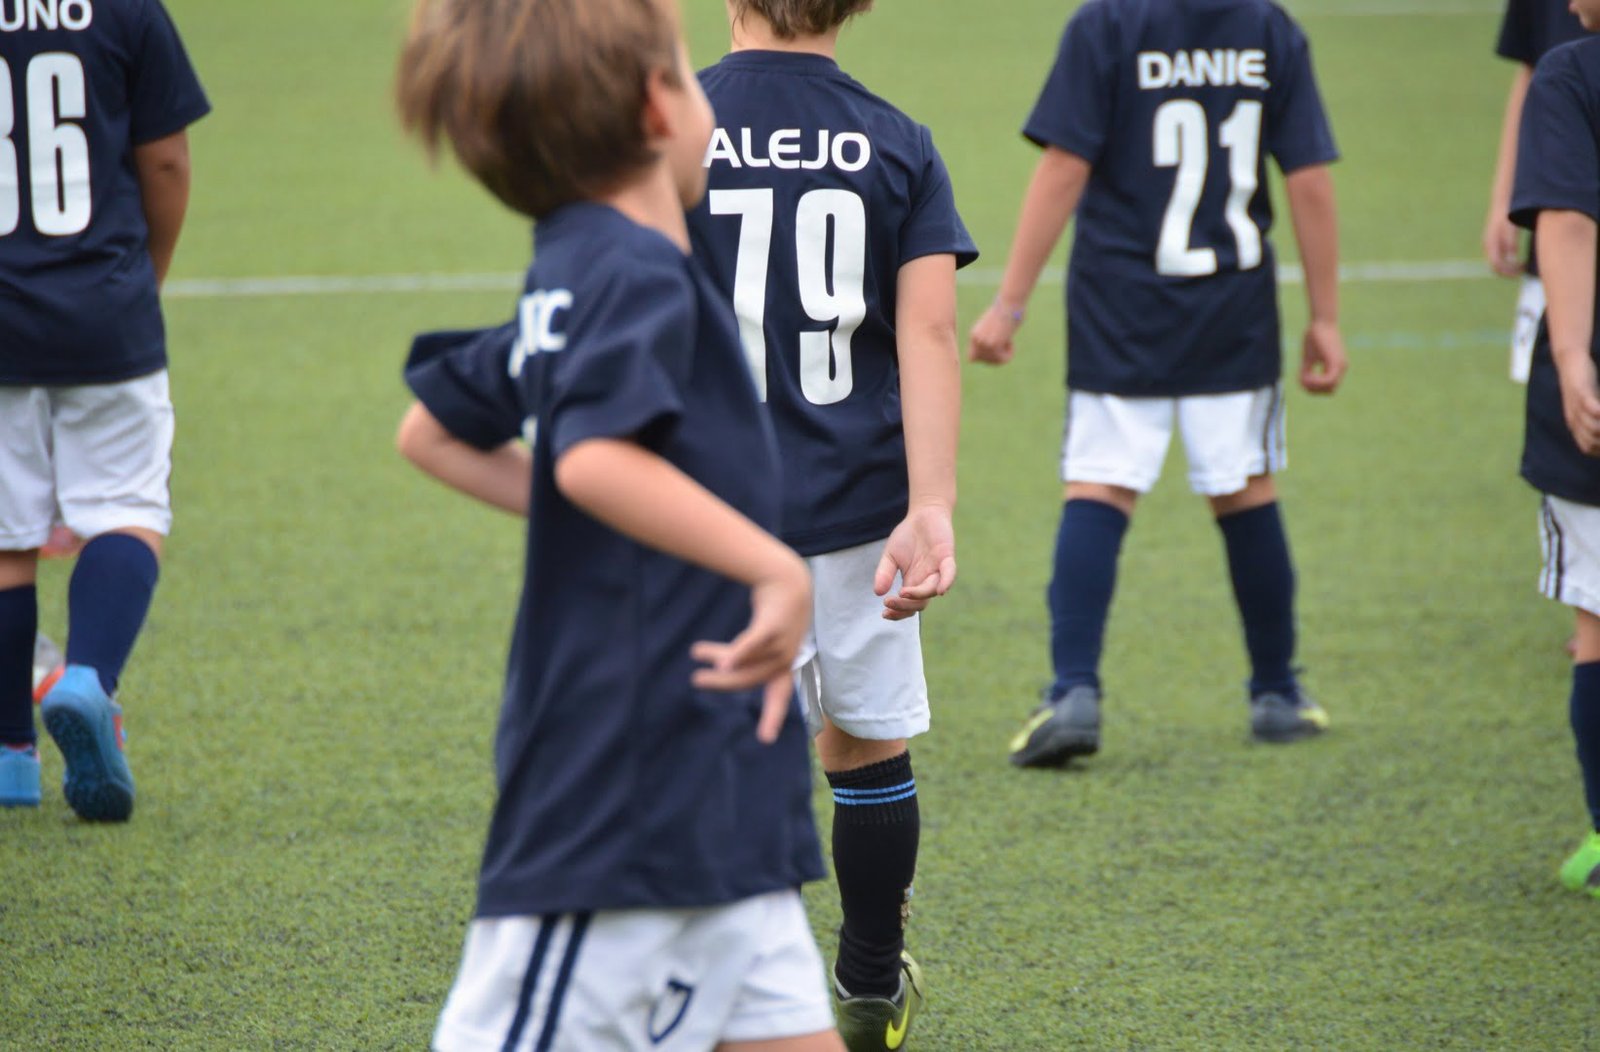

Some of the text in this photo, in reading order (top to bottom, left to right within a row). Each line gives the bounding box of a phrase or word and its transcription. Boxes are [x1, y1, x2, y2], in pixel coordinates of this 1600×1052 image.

[702, 127, 871, 172] ALEJO
[1153, 99, 1262, 276] 21
[709, 187, 867, 406] 79
